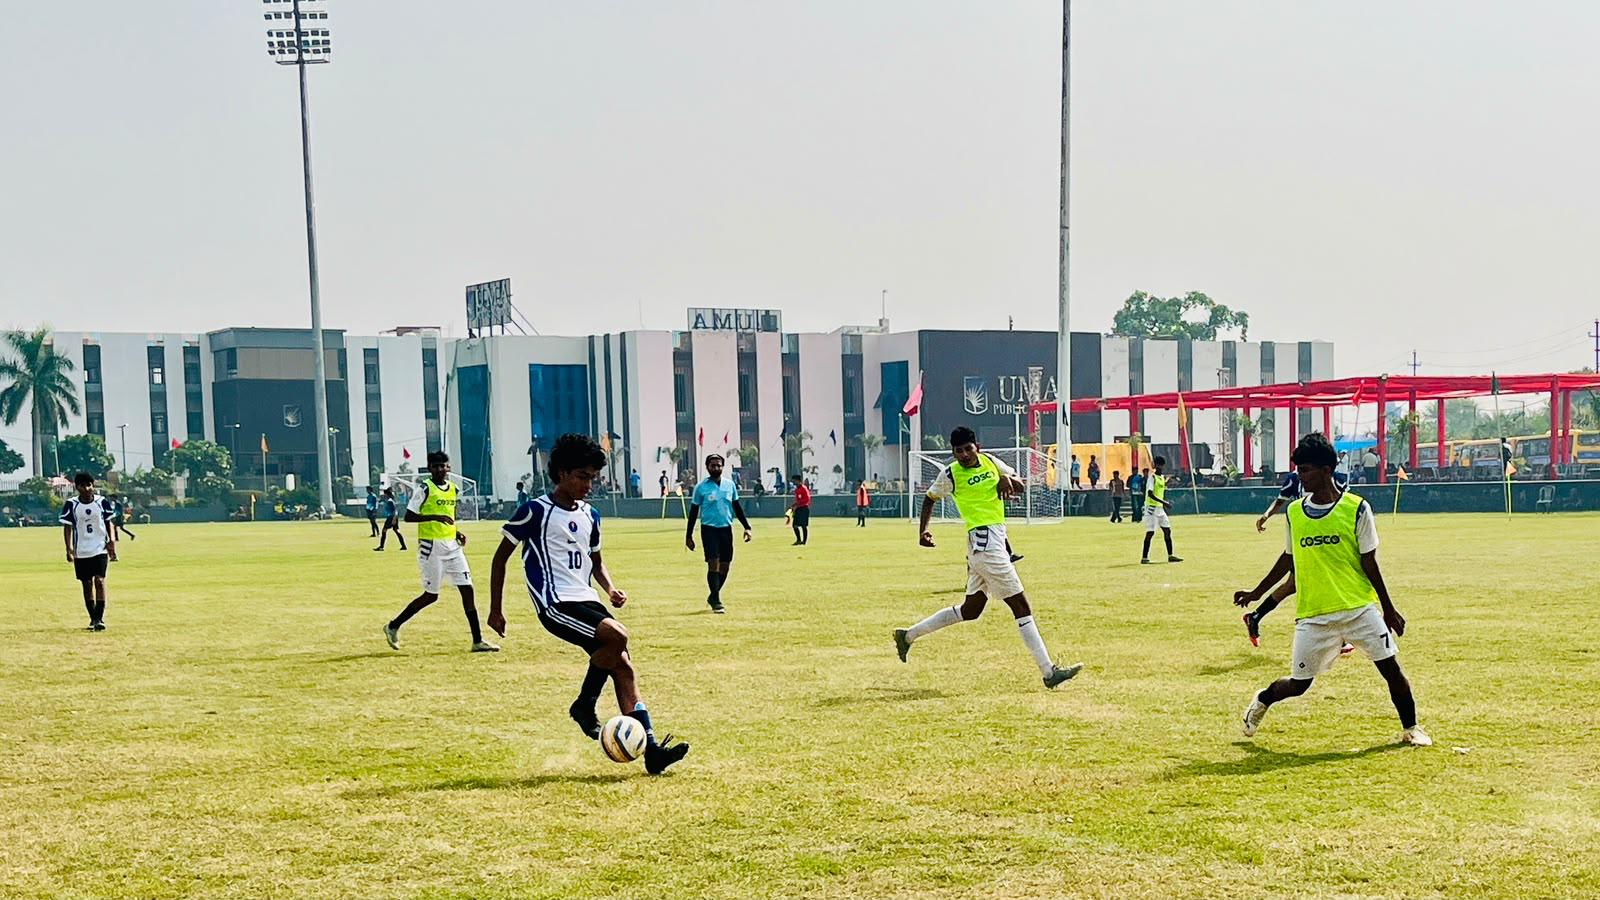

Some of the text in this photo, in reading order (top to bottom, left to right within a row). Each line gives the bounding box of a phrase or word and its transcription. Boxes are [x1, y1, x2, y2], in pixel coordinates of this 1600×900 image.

[87, 524, 93, 534] 6
[1300, 535, 1340, 547] COSCO
[567, 551, 582, 569] 10
[1380, 632, 1390, 649] 7
